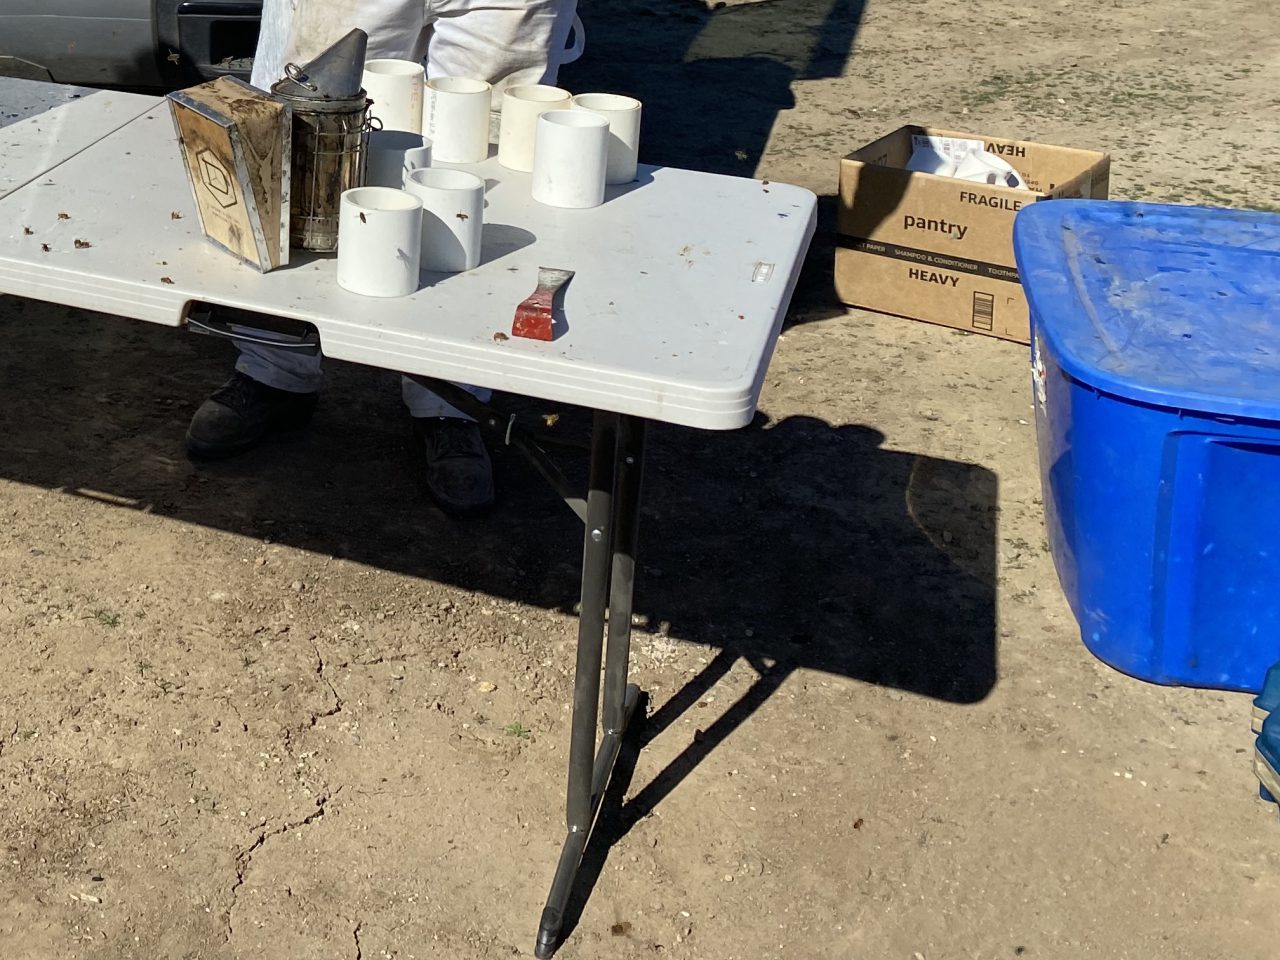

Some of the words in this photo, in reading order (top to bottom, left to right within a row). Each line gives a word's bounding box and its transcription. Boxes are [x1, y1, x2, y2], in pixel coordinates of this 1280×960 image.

[987, 142, 1026, 158] HEAV
[959, 191, 1022, 212] FRAGILE
[904, 214, 968, 240] pantry
[866, 243, 886, 253] PAPER
[894, 248, 927, 261] SHAMPOO
[933, 256, 978, 271] CONDITIONER
[908, 267, 960, 288] HEAVY
